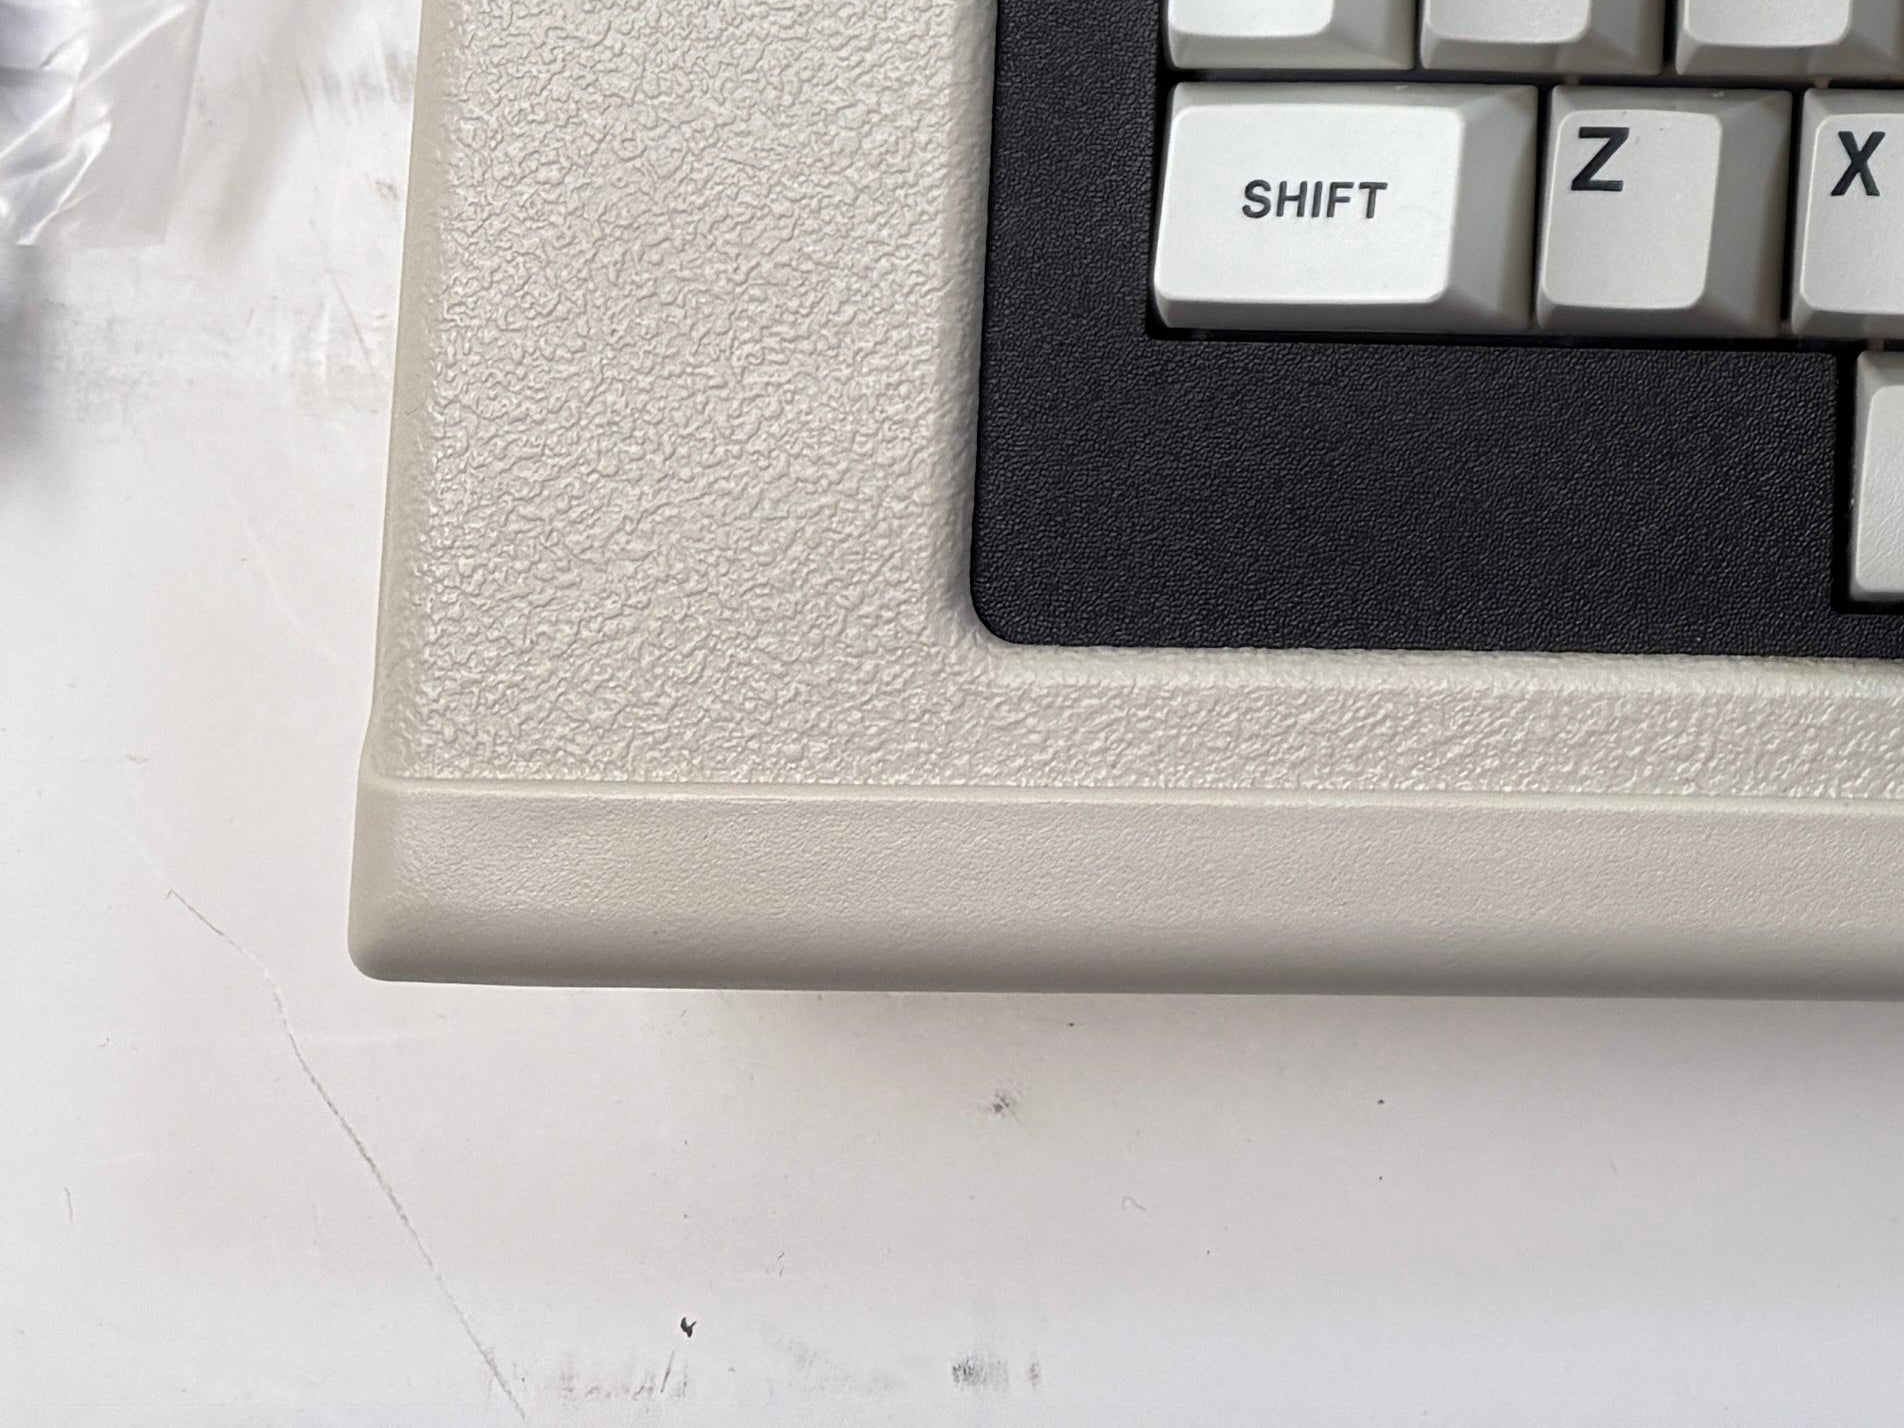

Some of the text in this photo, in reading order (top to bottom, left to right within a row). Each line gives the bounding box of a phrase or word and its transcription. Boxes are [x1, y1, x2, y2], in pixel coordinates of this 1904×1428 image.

[1571, 127, 1628, 191] Z
[1831, 132, 1885, 196] X
[1243, 180, 1386, 218] SHIFT
